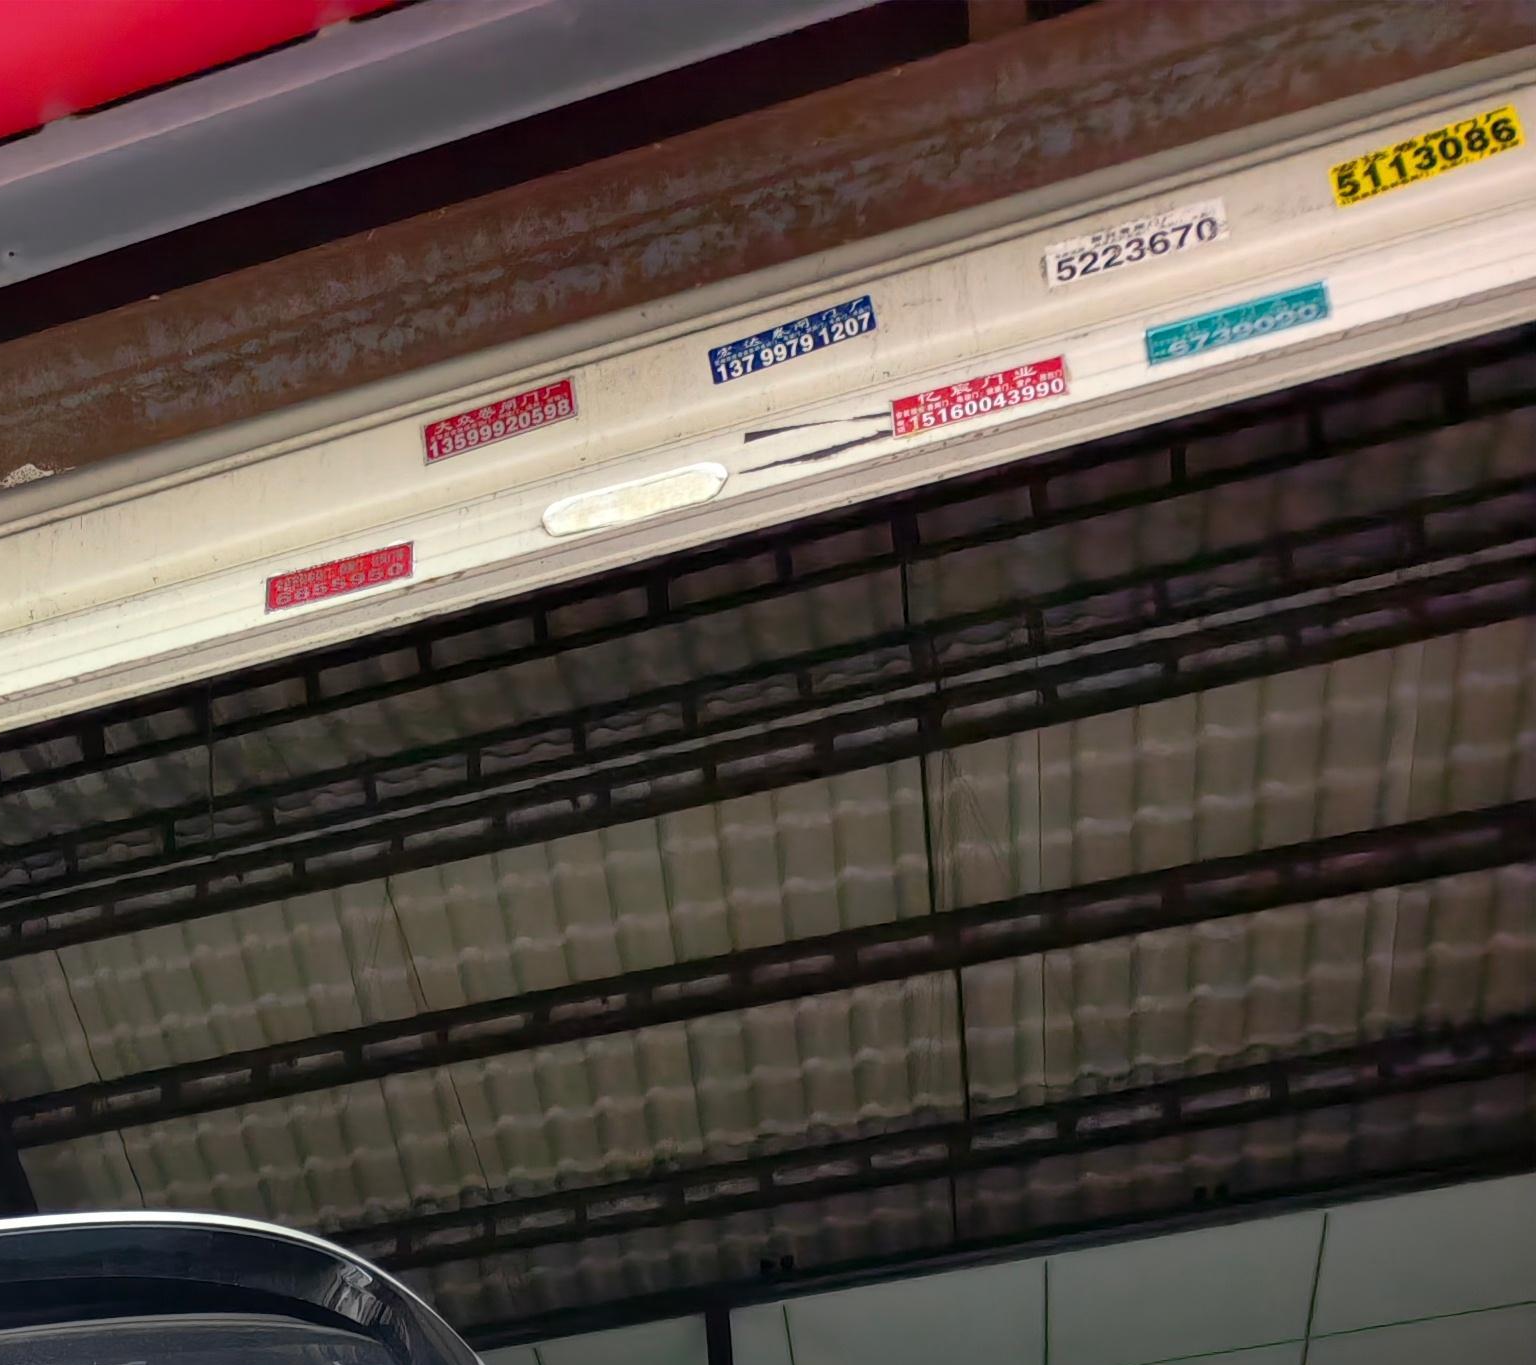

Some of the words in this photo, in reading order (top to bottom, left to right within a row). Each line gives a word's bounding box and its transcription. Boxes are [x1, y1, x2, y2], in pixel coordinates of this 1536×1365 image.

[1336, 118, 1517, 197] 5113086
[1056, 217, 1218, 281] 5223670
[716, 355, 755, 382] 137
[760, 334, 814, 367] 9979
[819, 312, 871, 345] 1207
[429, 399, 571, 458] 13599920598
[908, 377, 1064, 432] 15160043990
